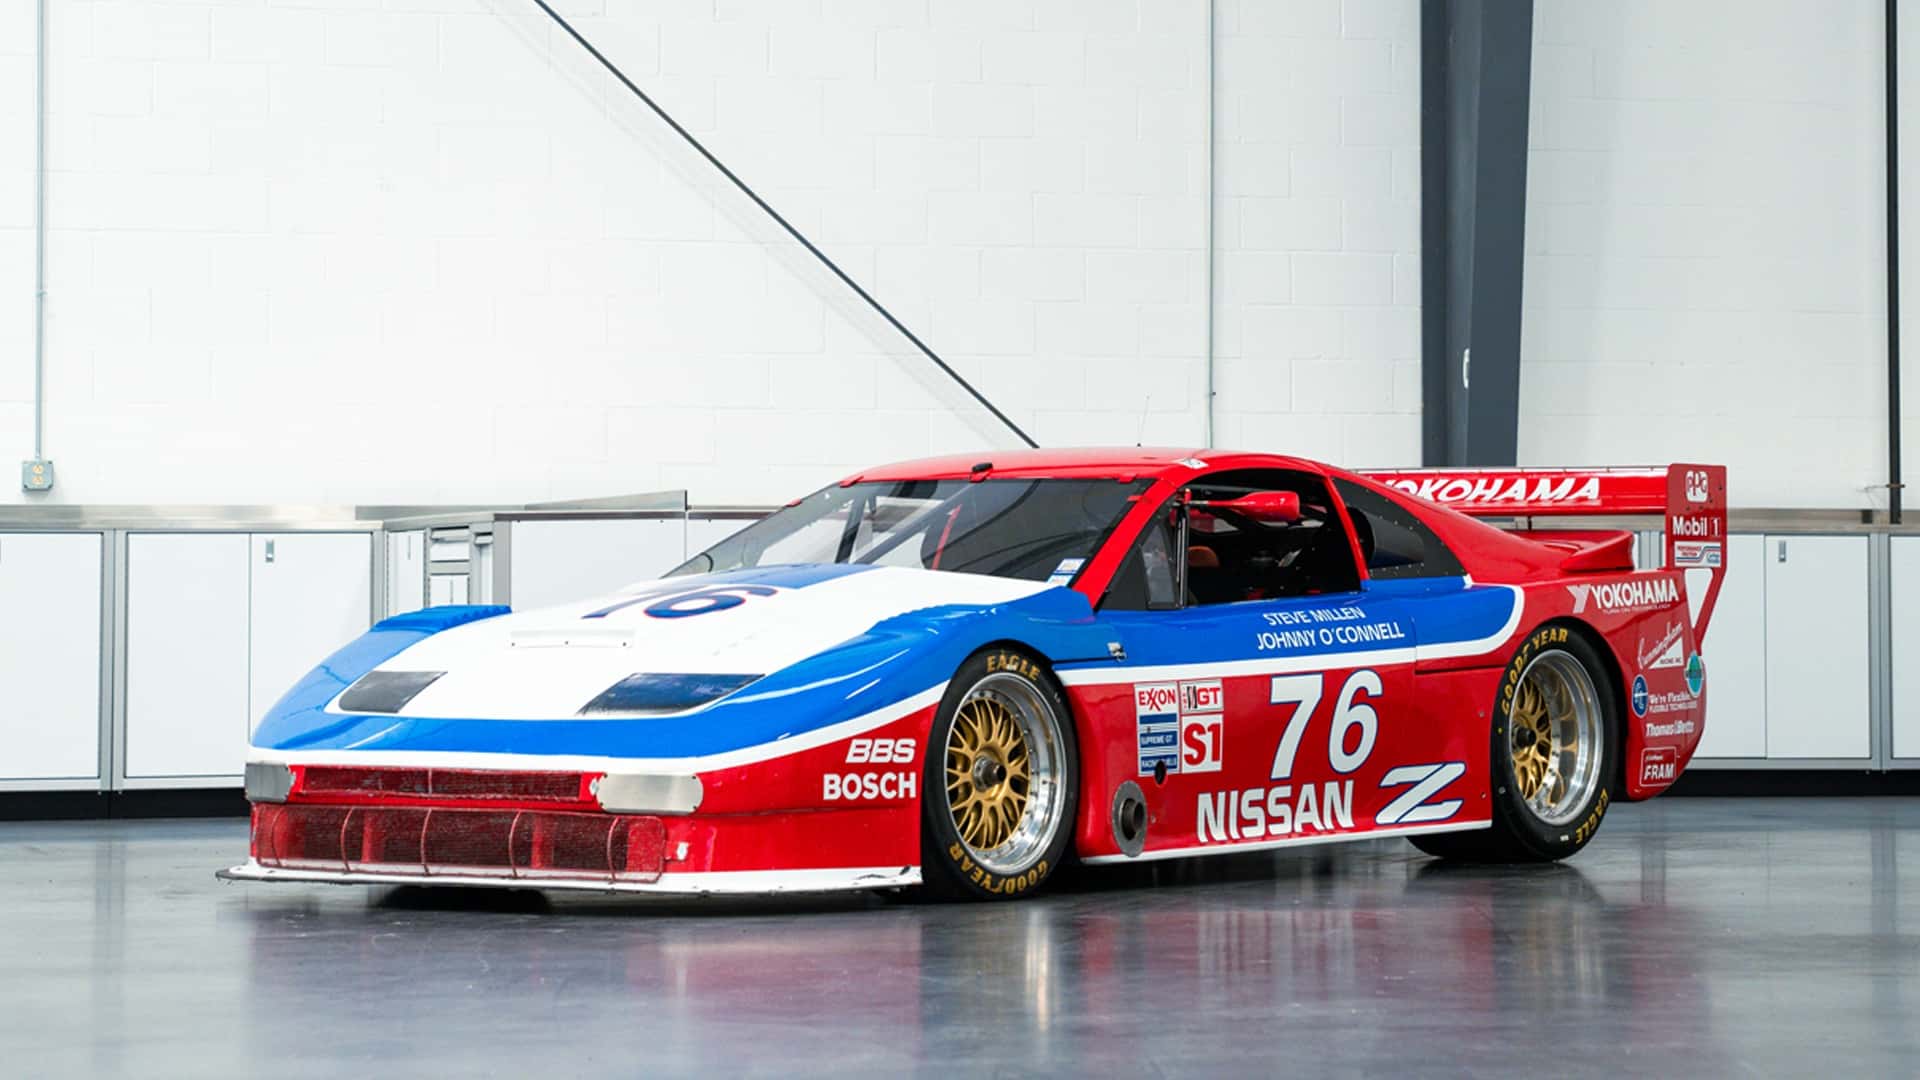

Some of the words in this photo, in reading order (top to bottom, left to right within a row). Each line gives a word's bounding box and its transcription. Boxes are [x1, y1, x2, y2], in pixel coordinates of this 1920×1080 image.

[1385, 477, 1600, 501] OKOHAMA
[1672, 516, 1707, 536] Mobil
[580, 585, 779, 620] 76
[1590, 578, 1680, 610] YOKOHAMA
[1262, 612, 1312, 627] STEVE
[1309, 606, 1367, 623] MILLEN
[1256, 629, 1317, 651] JOHNNY
[1319, 622, 1405, 646] O'CONNELL
[986, 655, 1041, 681] EAGLE
[1138, 688, 1177, 711] EXXON
[1197, 687, 1221, 706] GT
[1269, 668, 1383, 781] 76
[845, 738, 917, 764] BBS
[1183, 722, 1221, 766] S1
[1643, 764, 1675, 780] FRAM
[822, 771, 917, 800] BOSCH
[1196, 779, 1355, 843] NISSAN
